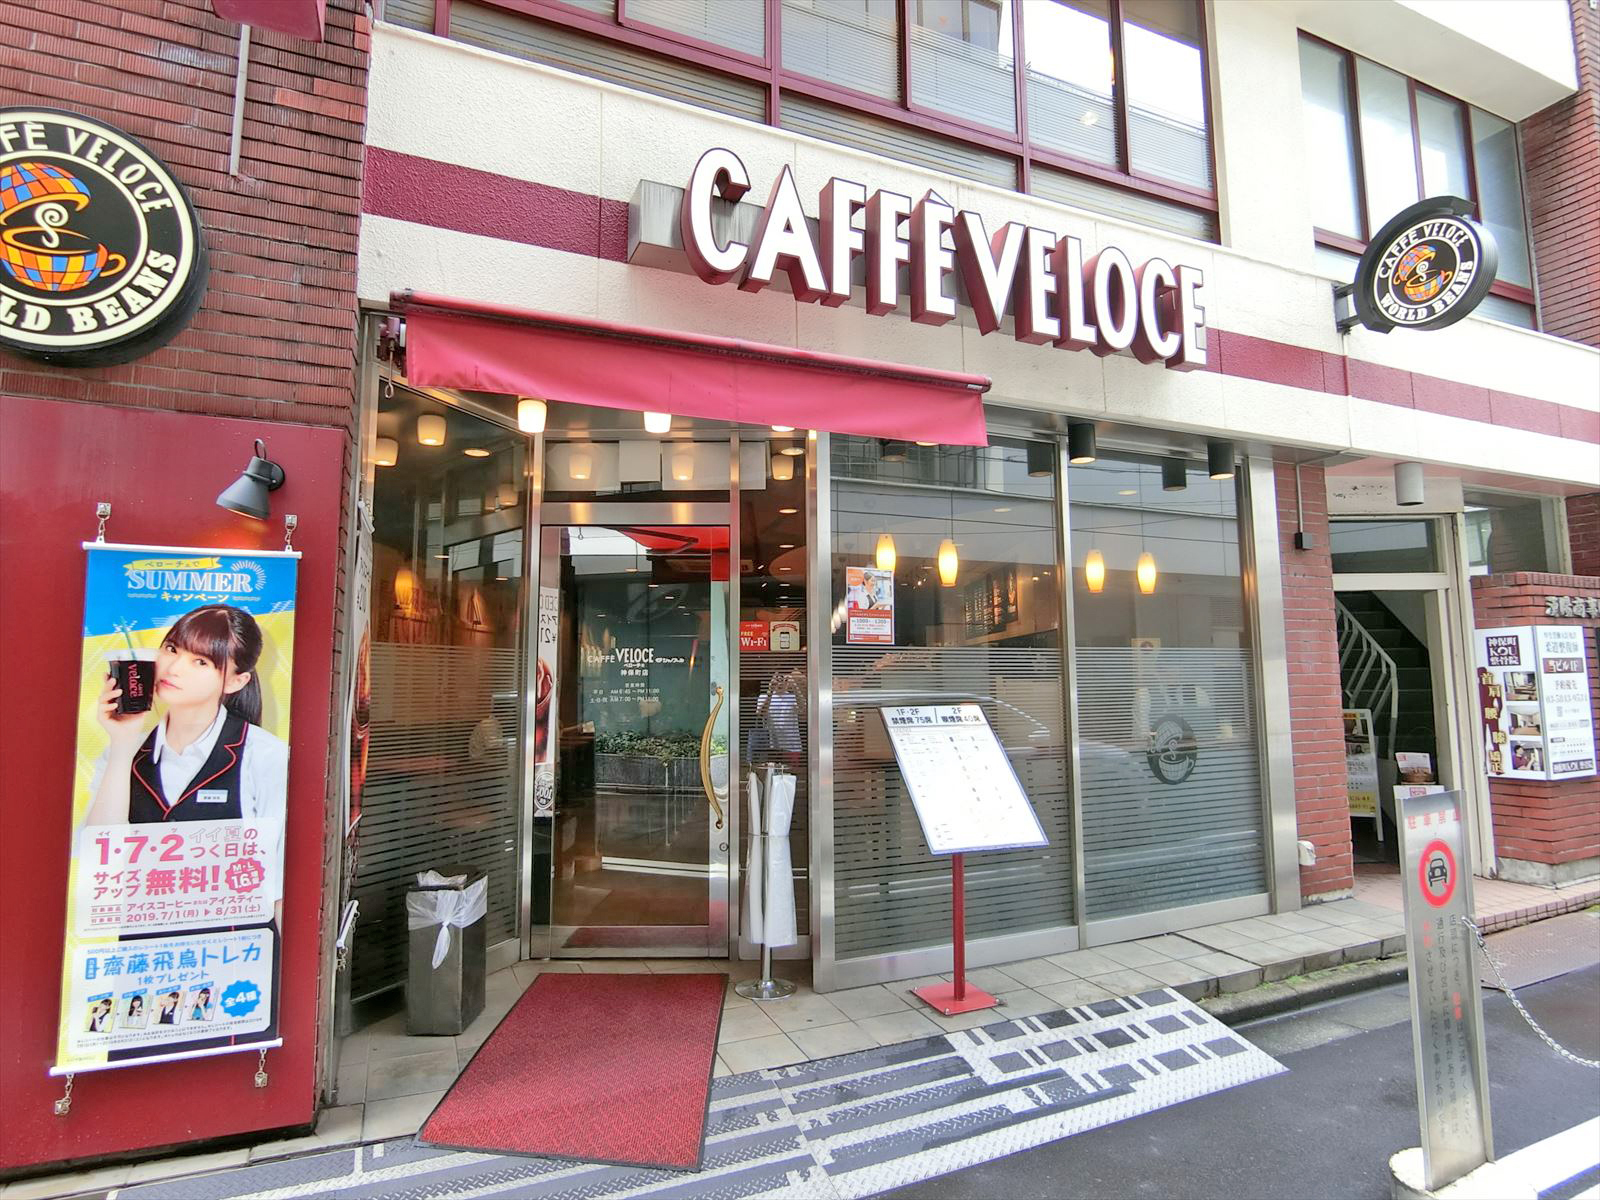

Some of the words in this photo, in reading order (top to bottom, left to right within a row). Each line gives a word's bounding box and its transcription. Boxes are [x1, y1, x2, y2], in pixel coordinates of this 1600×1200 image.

[67, 127, 173, 213] VELOCE
[1424, 223, 1469, 248] VELOCE
[67, 250, 177, 333] BEANS
[955, 209, 1207, 372] VELOCE
[1380, 292, 1428, 321] WORLD
[1431, 260, 1474, 314] BEANS
[144, 559, 201, 569] ベローチェで
[128, 569, 253, 593] SUMMER
[160, 591, 230, 603] キャンペーン
[615, 648, 655, 663] VELOCE
[1489, 646, 1518, 656] KOU
[128, 664, 141, 698] veloce
[94, 868, 142, 884] サイズ
[93, 884, 141, 900] アップ
